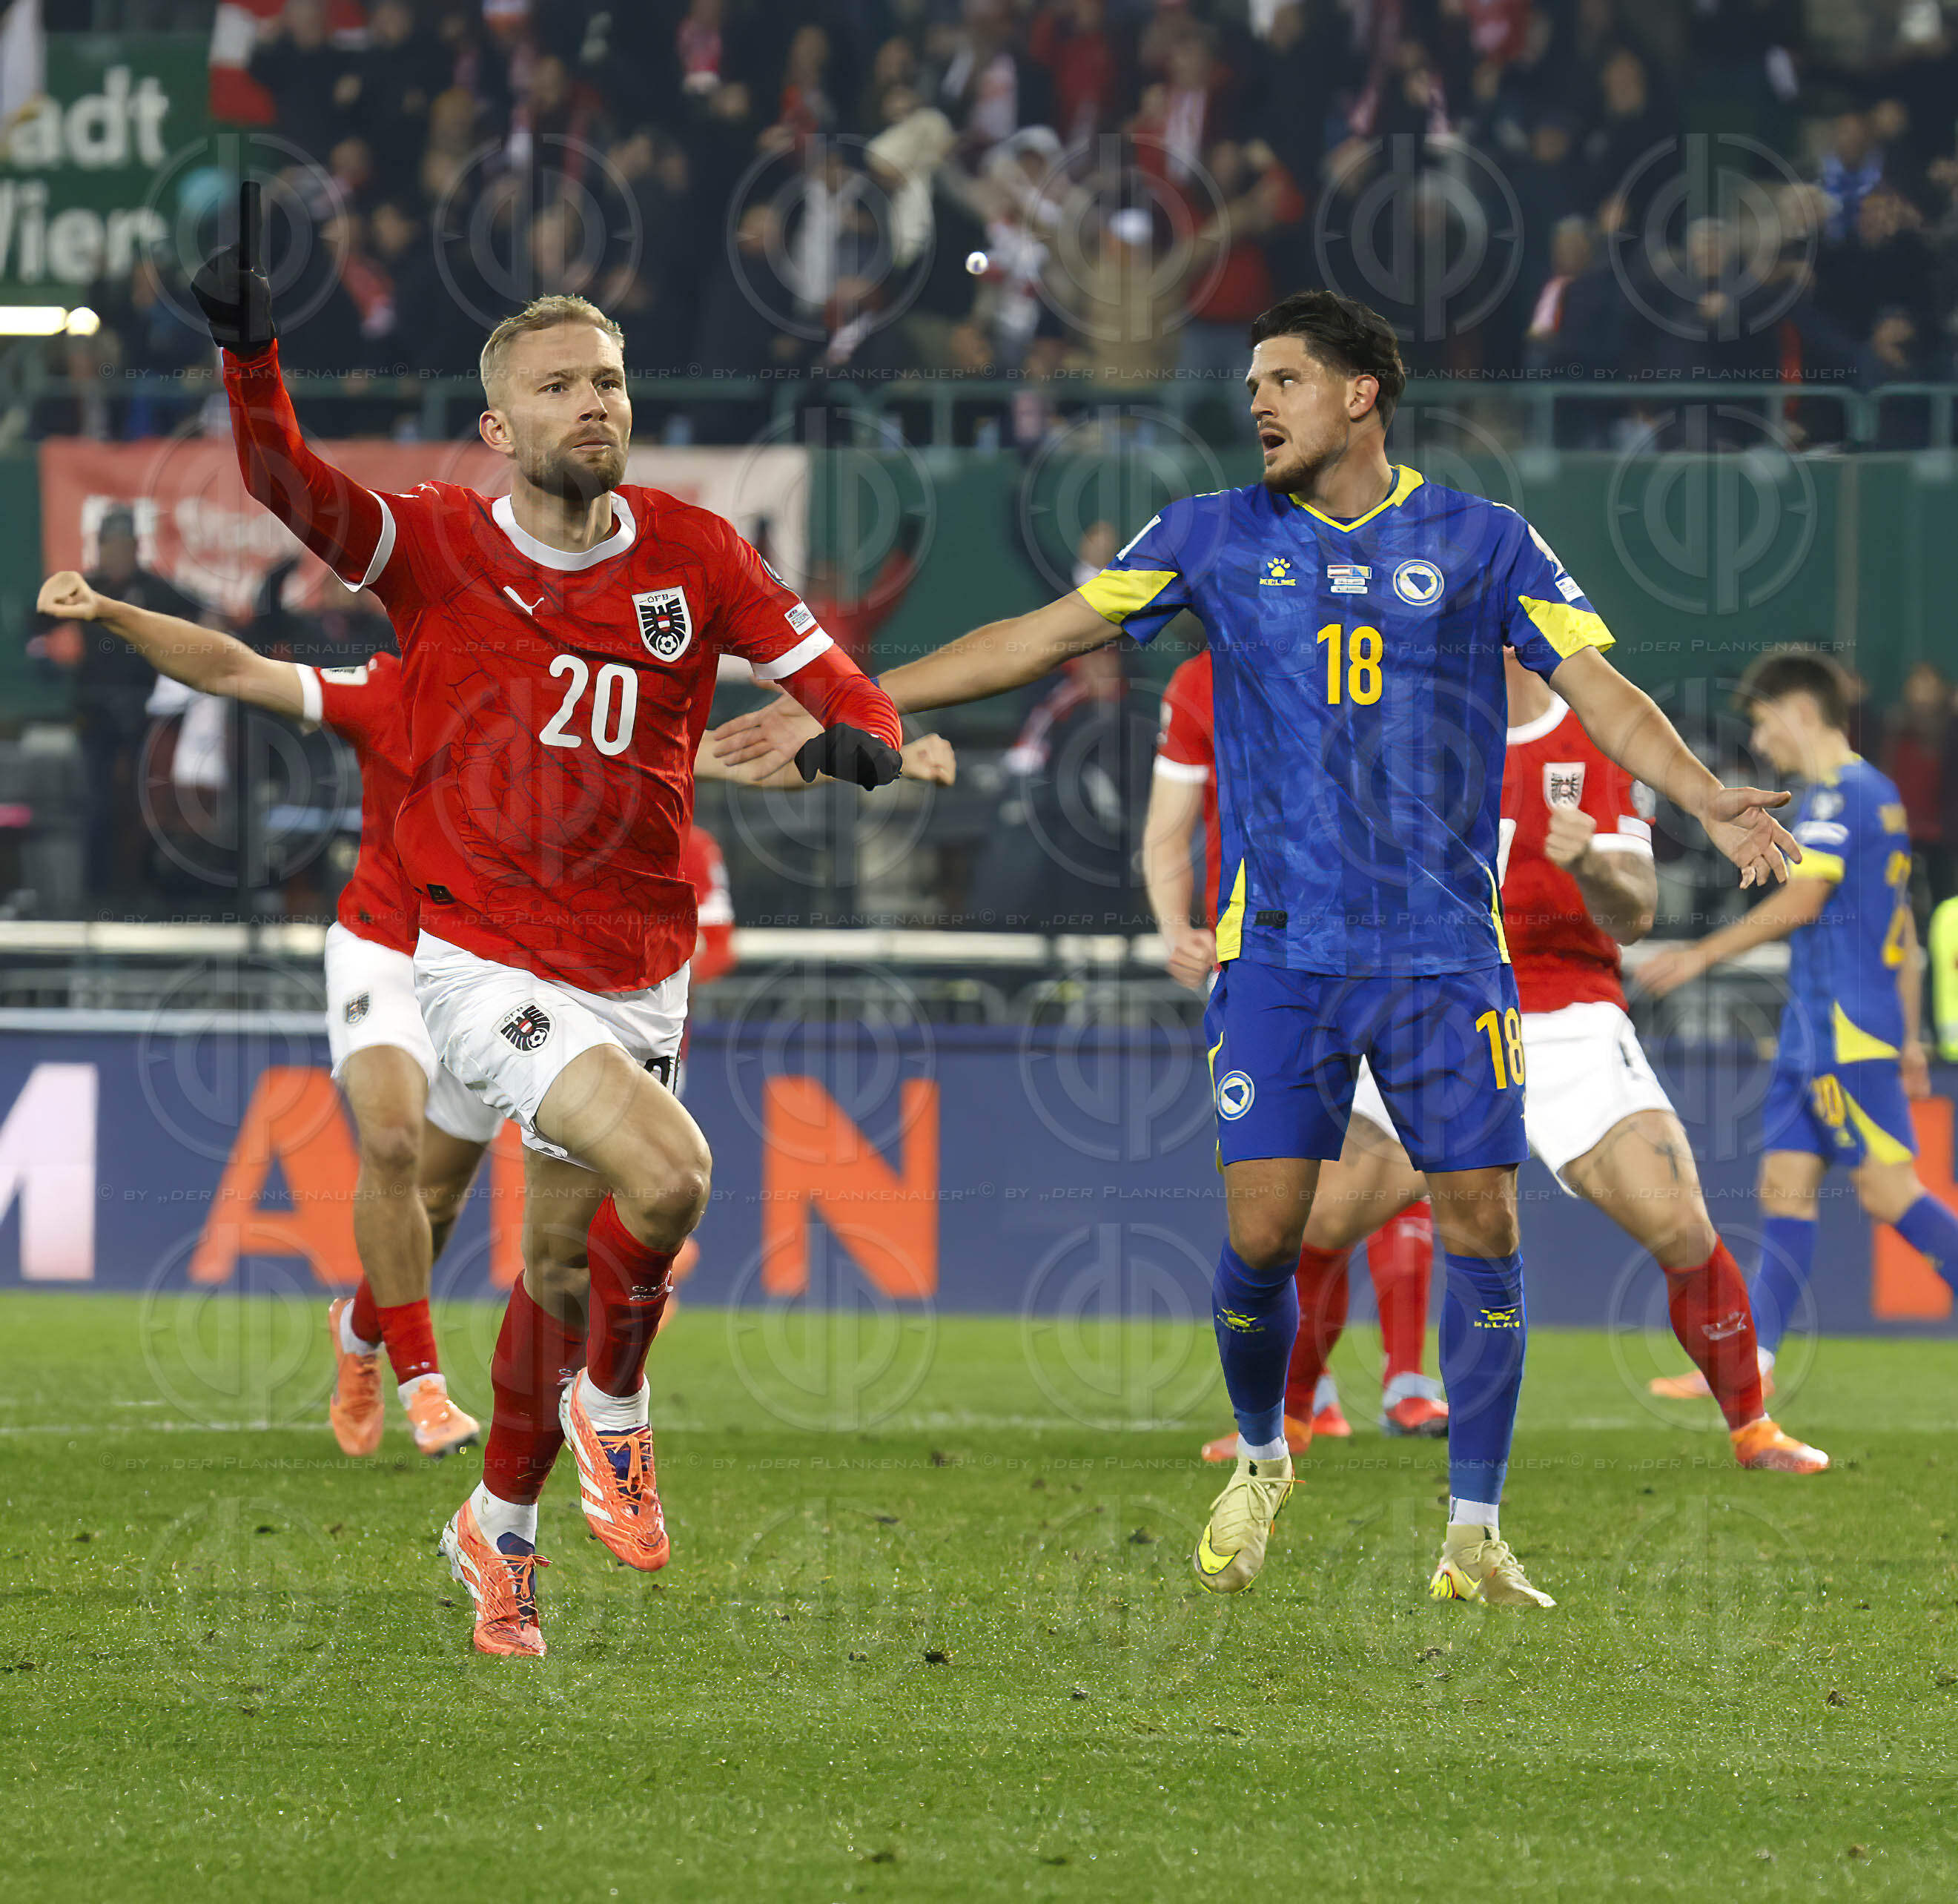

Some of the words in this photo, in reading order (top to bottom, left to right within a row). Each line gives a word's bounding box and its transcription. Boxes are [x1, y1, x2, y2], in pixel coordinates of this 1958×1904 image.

[539, 654, 638, 756] 20
[1317, 624, 1383, 706] 18
[1475, 1008, 1525, 1090] 18
